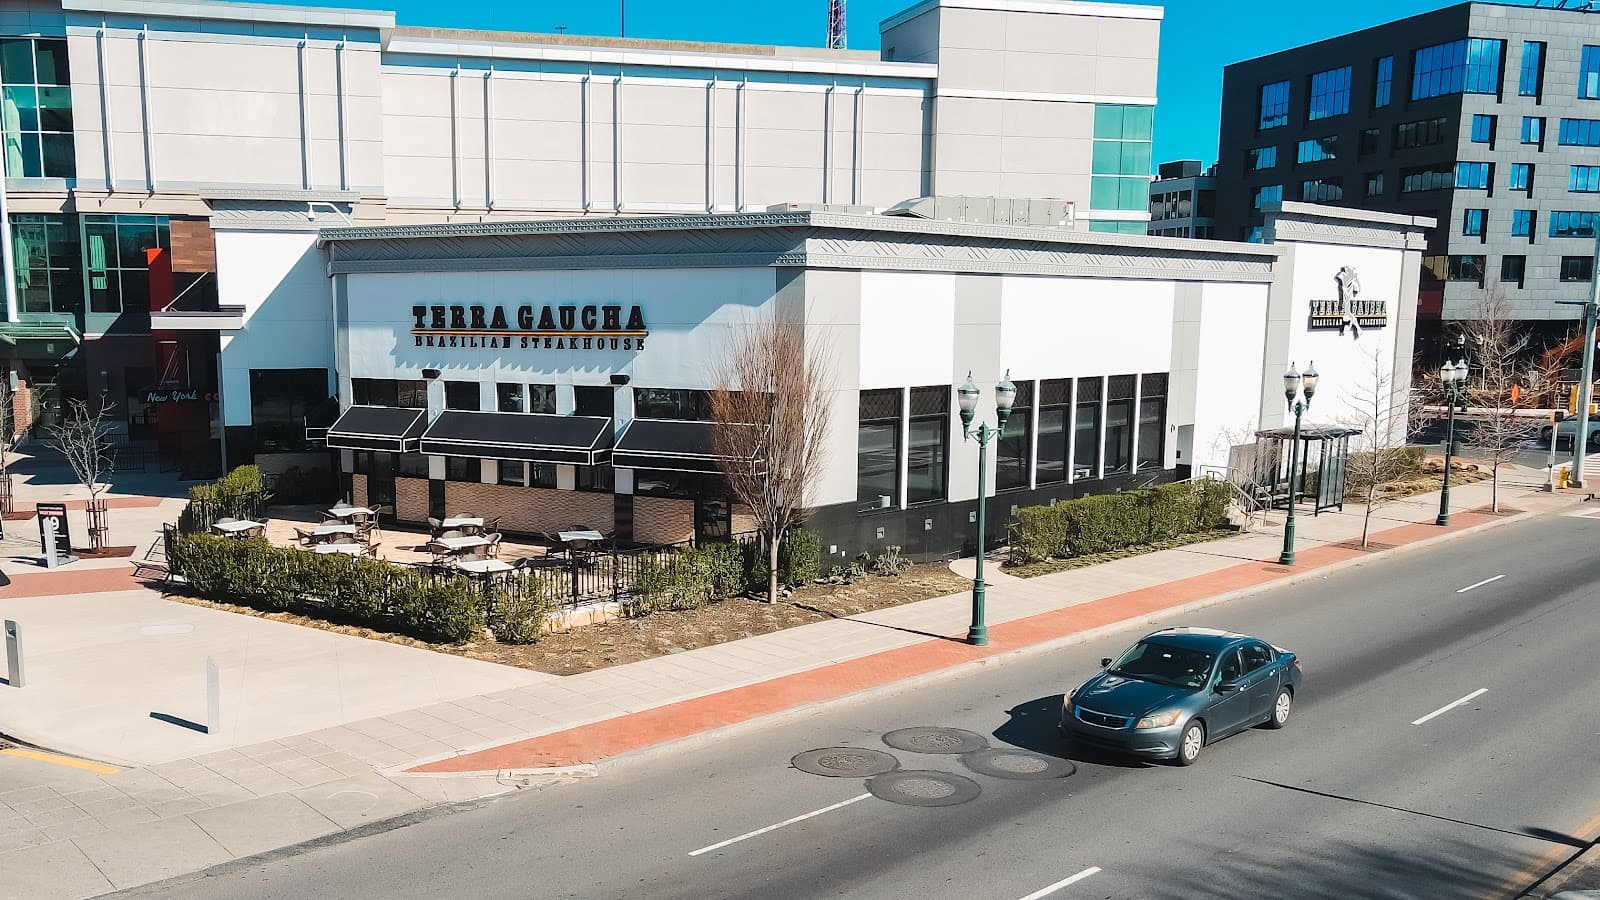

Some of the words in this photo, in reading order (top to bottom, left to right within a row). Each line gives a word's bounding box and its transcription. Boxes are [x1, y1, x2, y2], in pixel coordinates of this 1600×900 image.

[412, 305, 509, 329] TERRA
[517, 305, 647, 330] GAUCHA
[415, 336, 512, 349] BRAZILIAN
[520, 337, 645, 350] STEAKHOUSE
[146, 391, 169, 403] New
[172, 389, 198, 403] York
